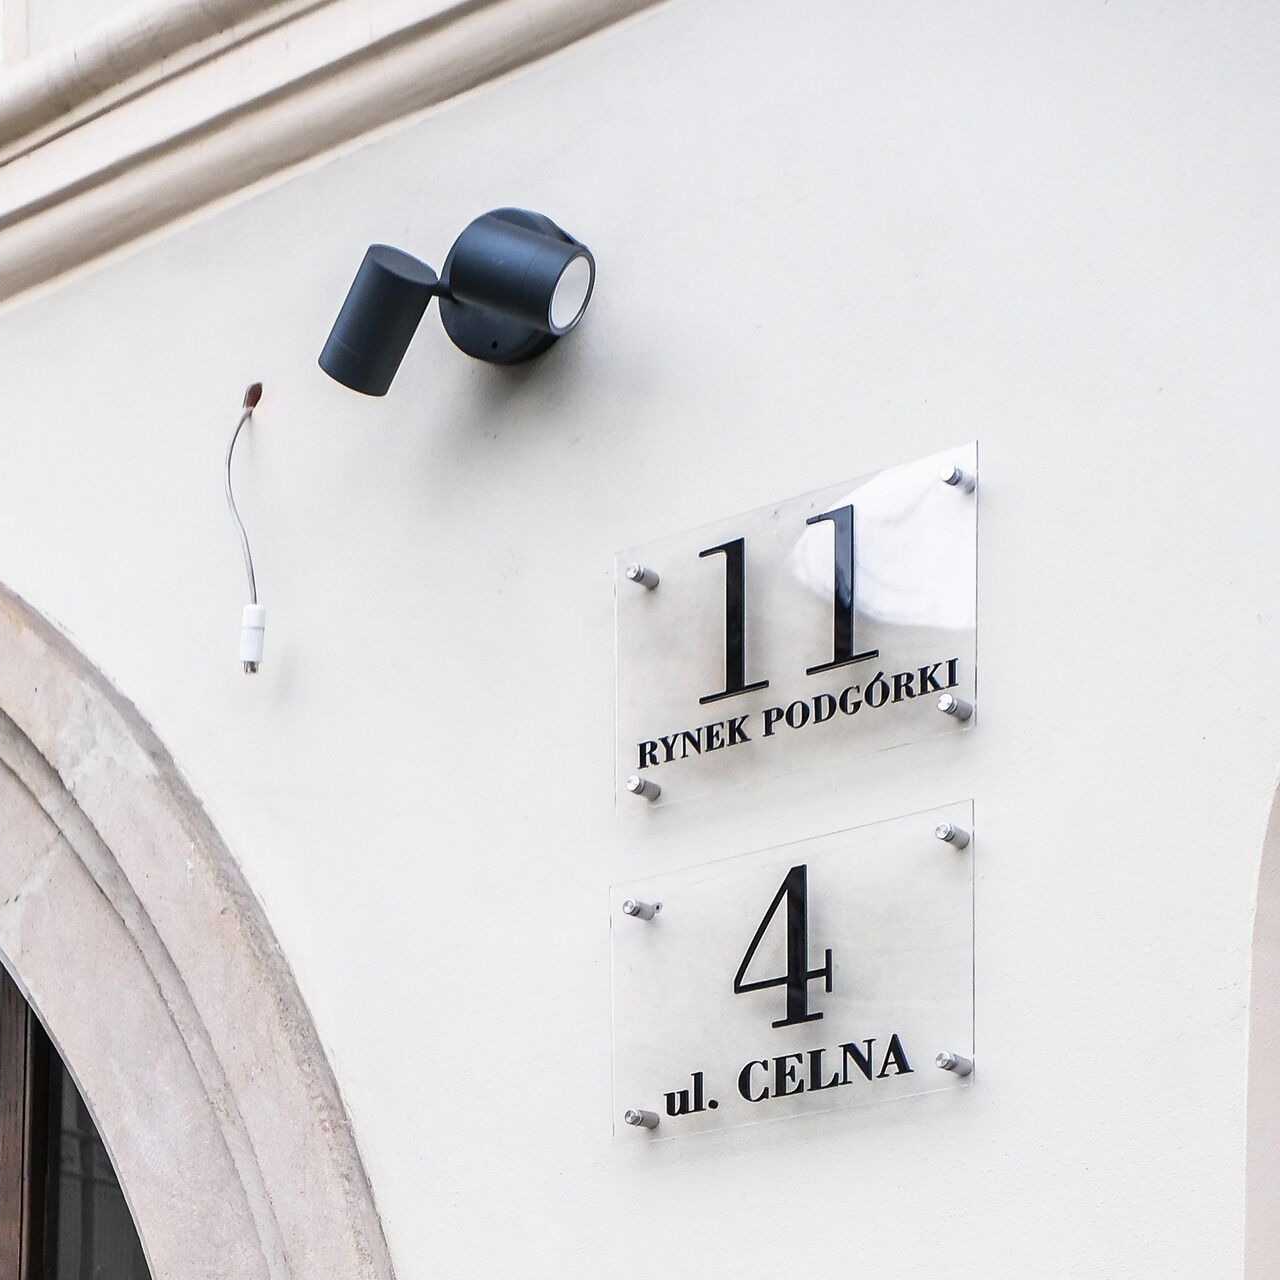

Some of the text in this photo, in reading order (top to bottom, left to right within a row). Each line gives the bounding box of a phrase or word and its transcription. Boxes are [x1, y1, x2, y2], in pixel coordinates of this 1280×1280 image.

[697, 503, 881, 706] 11
[637, 656, 960, 770] RYNEK PODGÓRKI
[732, 863, 834, 1029] 4
[662, 1032, 916, 1118] ul. CELNA
